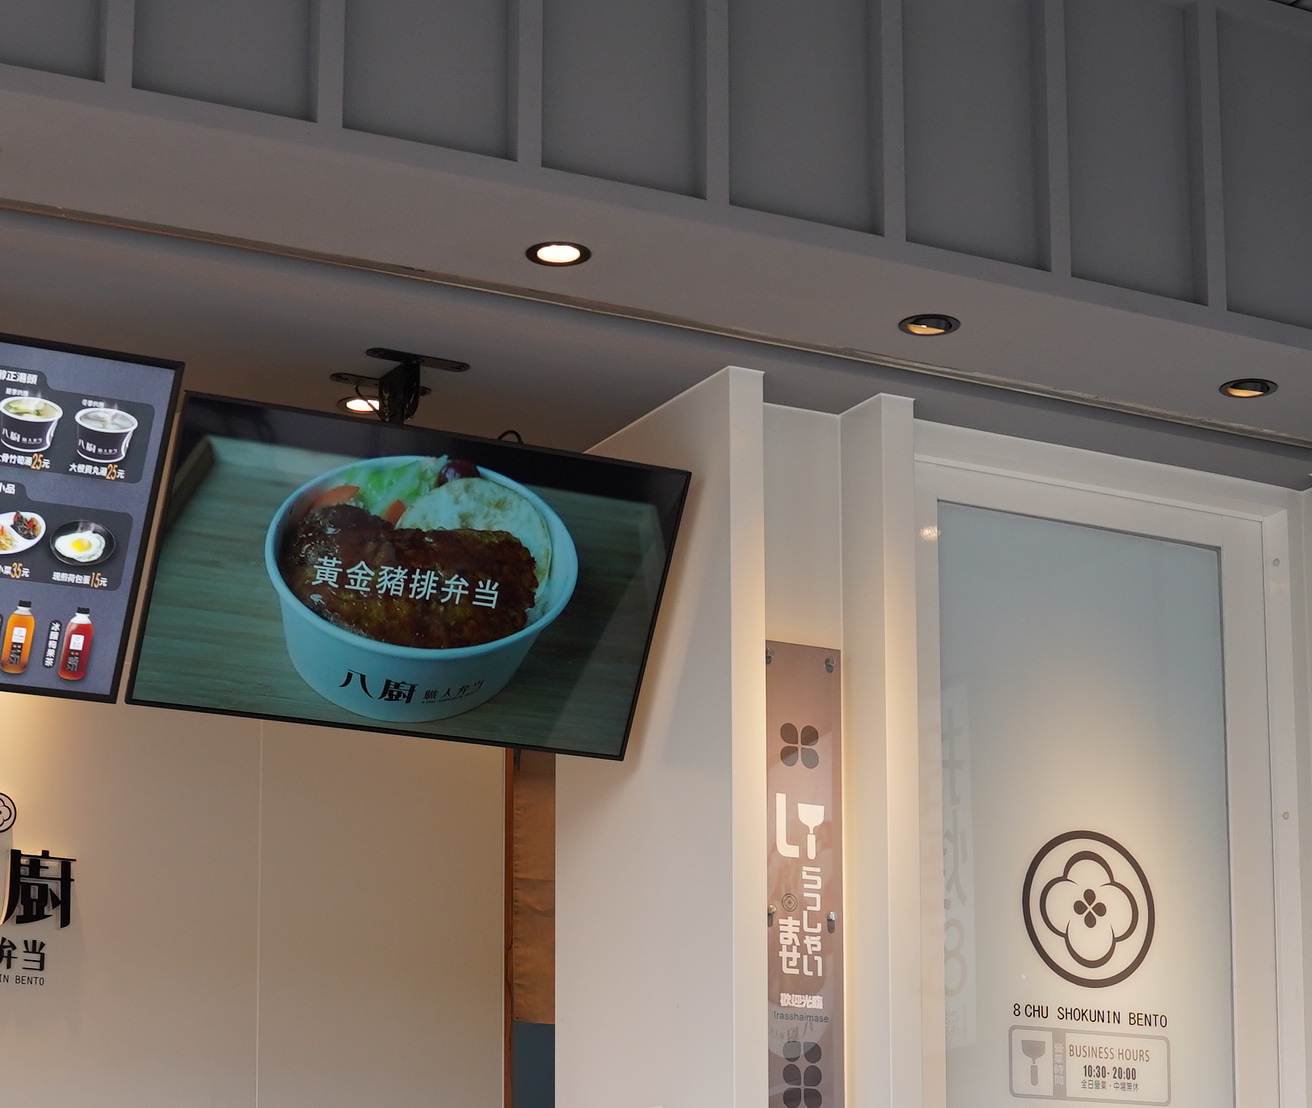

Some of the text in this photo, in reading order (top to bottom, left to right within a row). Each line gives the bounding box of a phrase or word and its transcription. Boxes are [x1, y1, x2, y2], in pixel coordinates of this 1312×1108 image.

[312, 556, 499, 609] 黃金豬排弁当
[339, 668, 419, 704] 八廚
[15, 976, 45, 986] BENTO
[773, 1011, 829, 1023] Irasshaimase
[1013, 1003, 1167, 1027] 8 CHU SHOKUNIN BENTO
[1069, 1044, 1150, 1062] BUSINESS HOURS
[1113, 1067, 1136, 1080] 20:00
